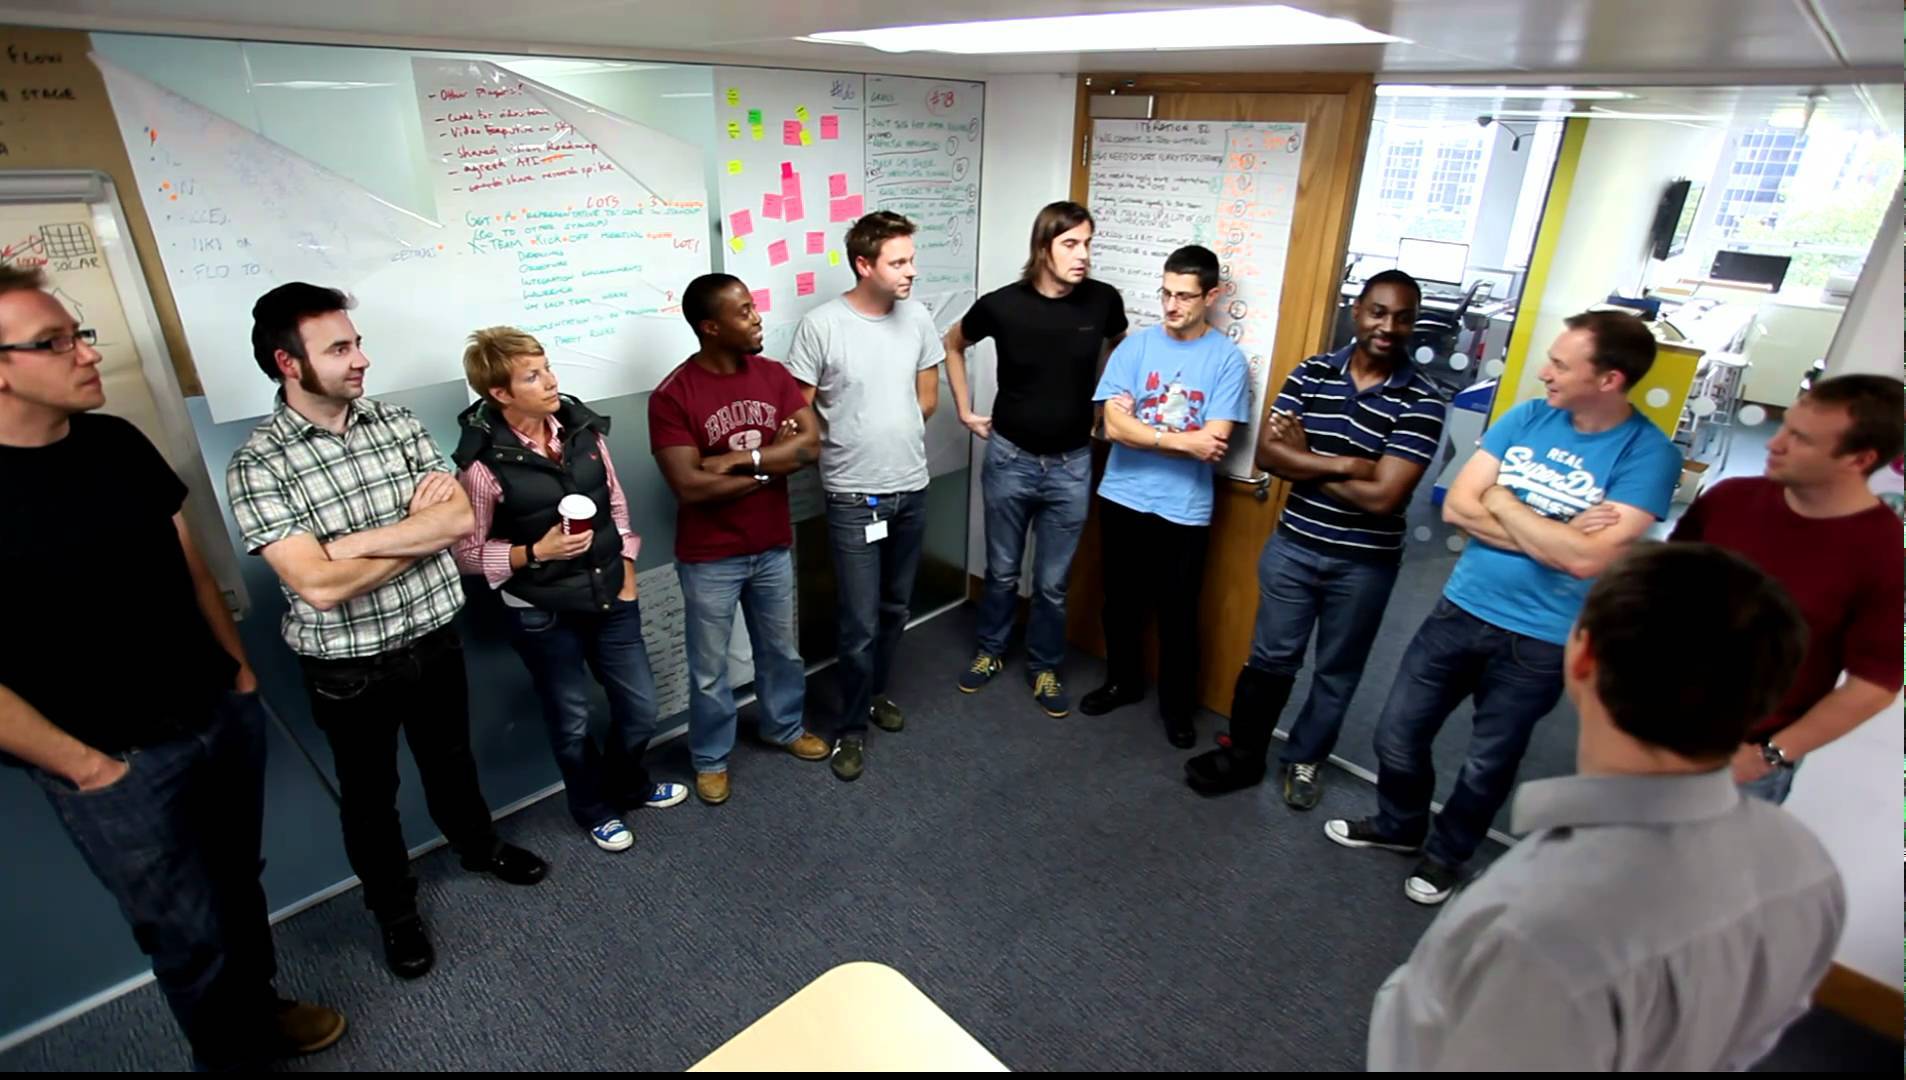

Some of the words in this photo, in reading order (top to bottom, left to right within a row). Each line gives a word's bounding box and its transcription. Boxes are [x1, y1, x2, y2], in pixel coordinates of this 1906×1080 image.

[586, 193, 620, 209] LOTS
[704, 399, 777, 447] BRONX
[1546, 447, 1584, 469] REAL
